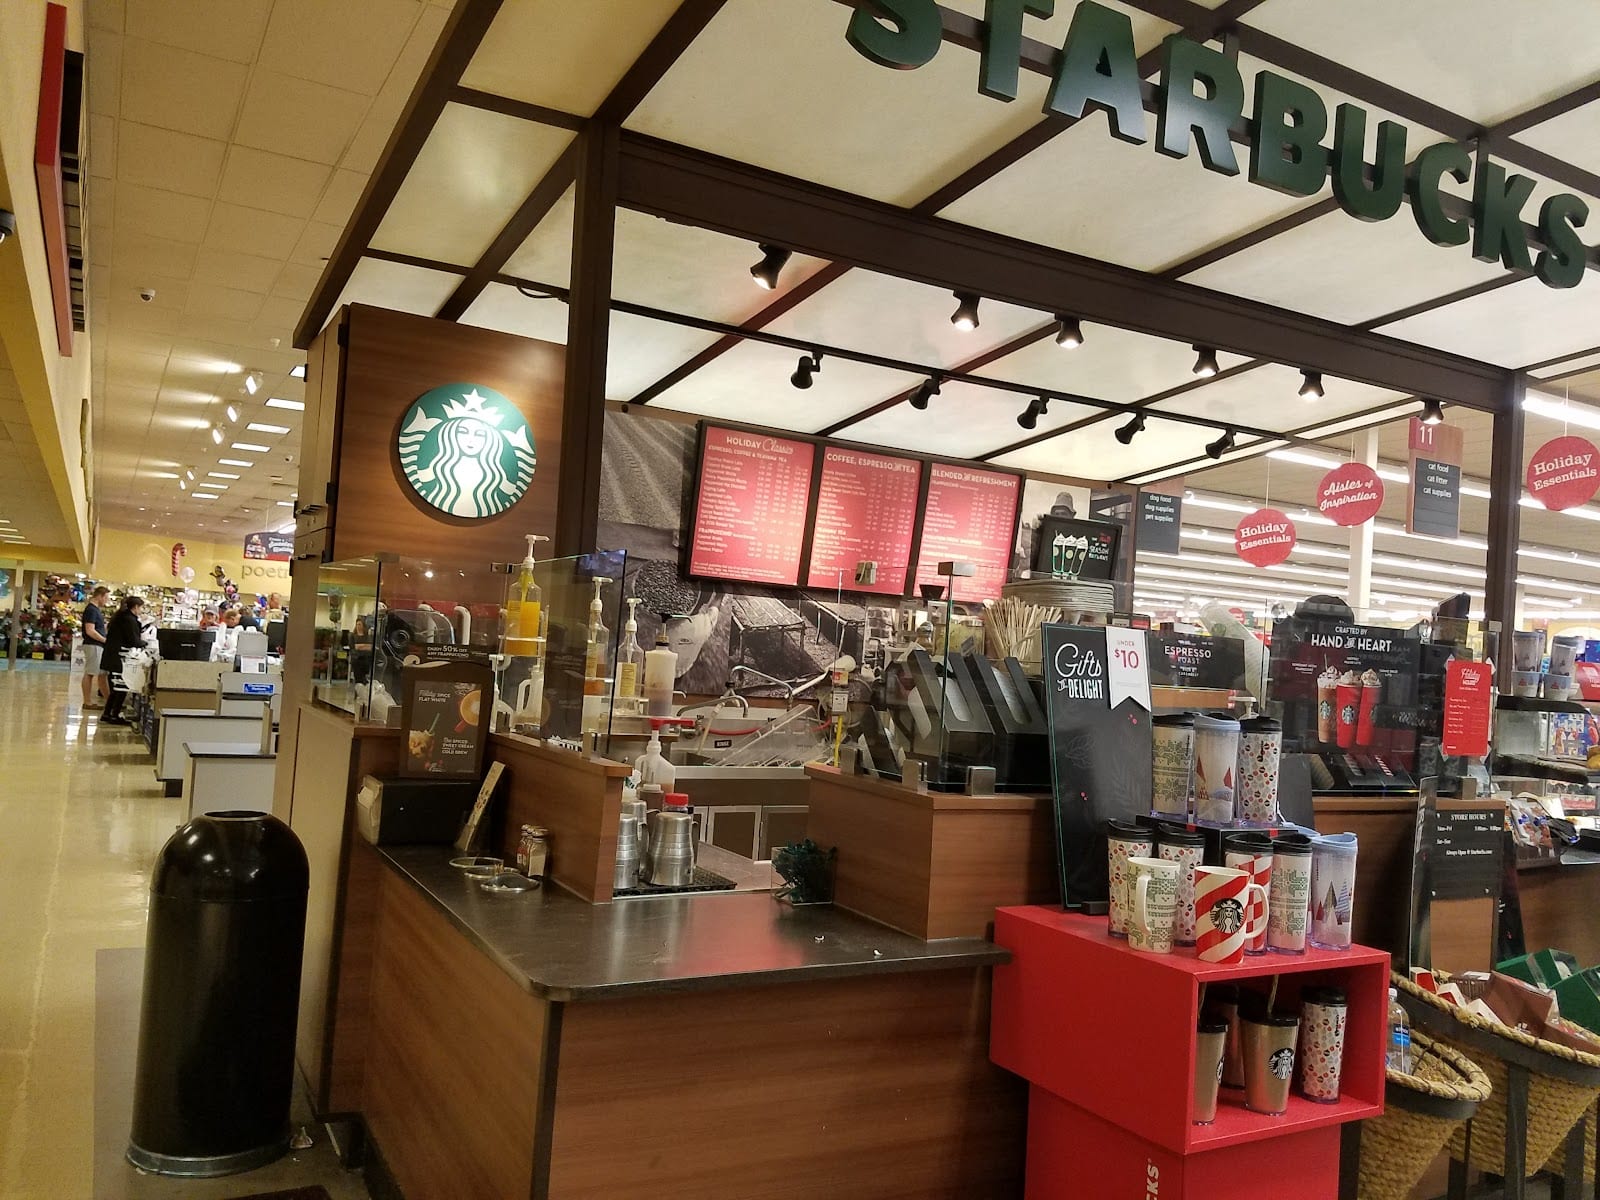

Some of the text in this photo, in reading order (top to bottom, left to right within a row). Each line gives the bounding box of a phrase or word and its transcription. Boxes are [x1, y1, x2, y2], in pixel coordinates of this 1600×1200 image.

[845, 0, 1590, 289] STARBUCKS
[726, 436, 761, 448] HOLIDAY
[1419, 425, 1434, 446] 11
[903, 465, 916, 473] TEA
[1533, 453, 1593, 476] Holiday
[1323, 479, 1374, 496] Aisles of
[1533, 467, 1597, 491] Essentials
[1319, 491, 1378, 511] Inspiration
[1240, 523, 1288, 538] Holiday
[1239, 534, 1292, 551] Essentials
[1335, 626, 1368, 635] CRAFTED BY
[442, 645, 459, 653] 50%
[1311, 634, 1343, 648] HAND
[1357, 639, 1392, 652] HEART
[1054, 643, 1102, 678] Gifts
[1114, 648, 1139, 669] $10
[1164, 645, 1212, 659] ESPRESSO
[1068, 678, 1103, 699] DELIGHT
[1451, 813, 1487, 821] STORE HOURS
